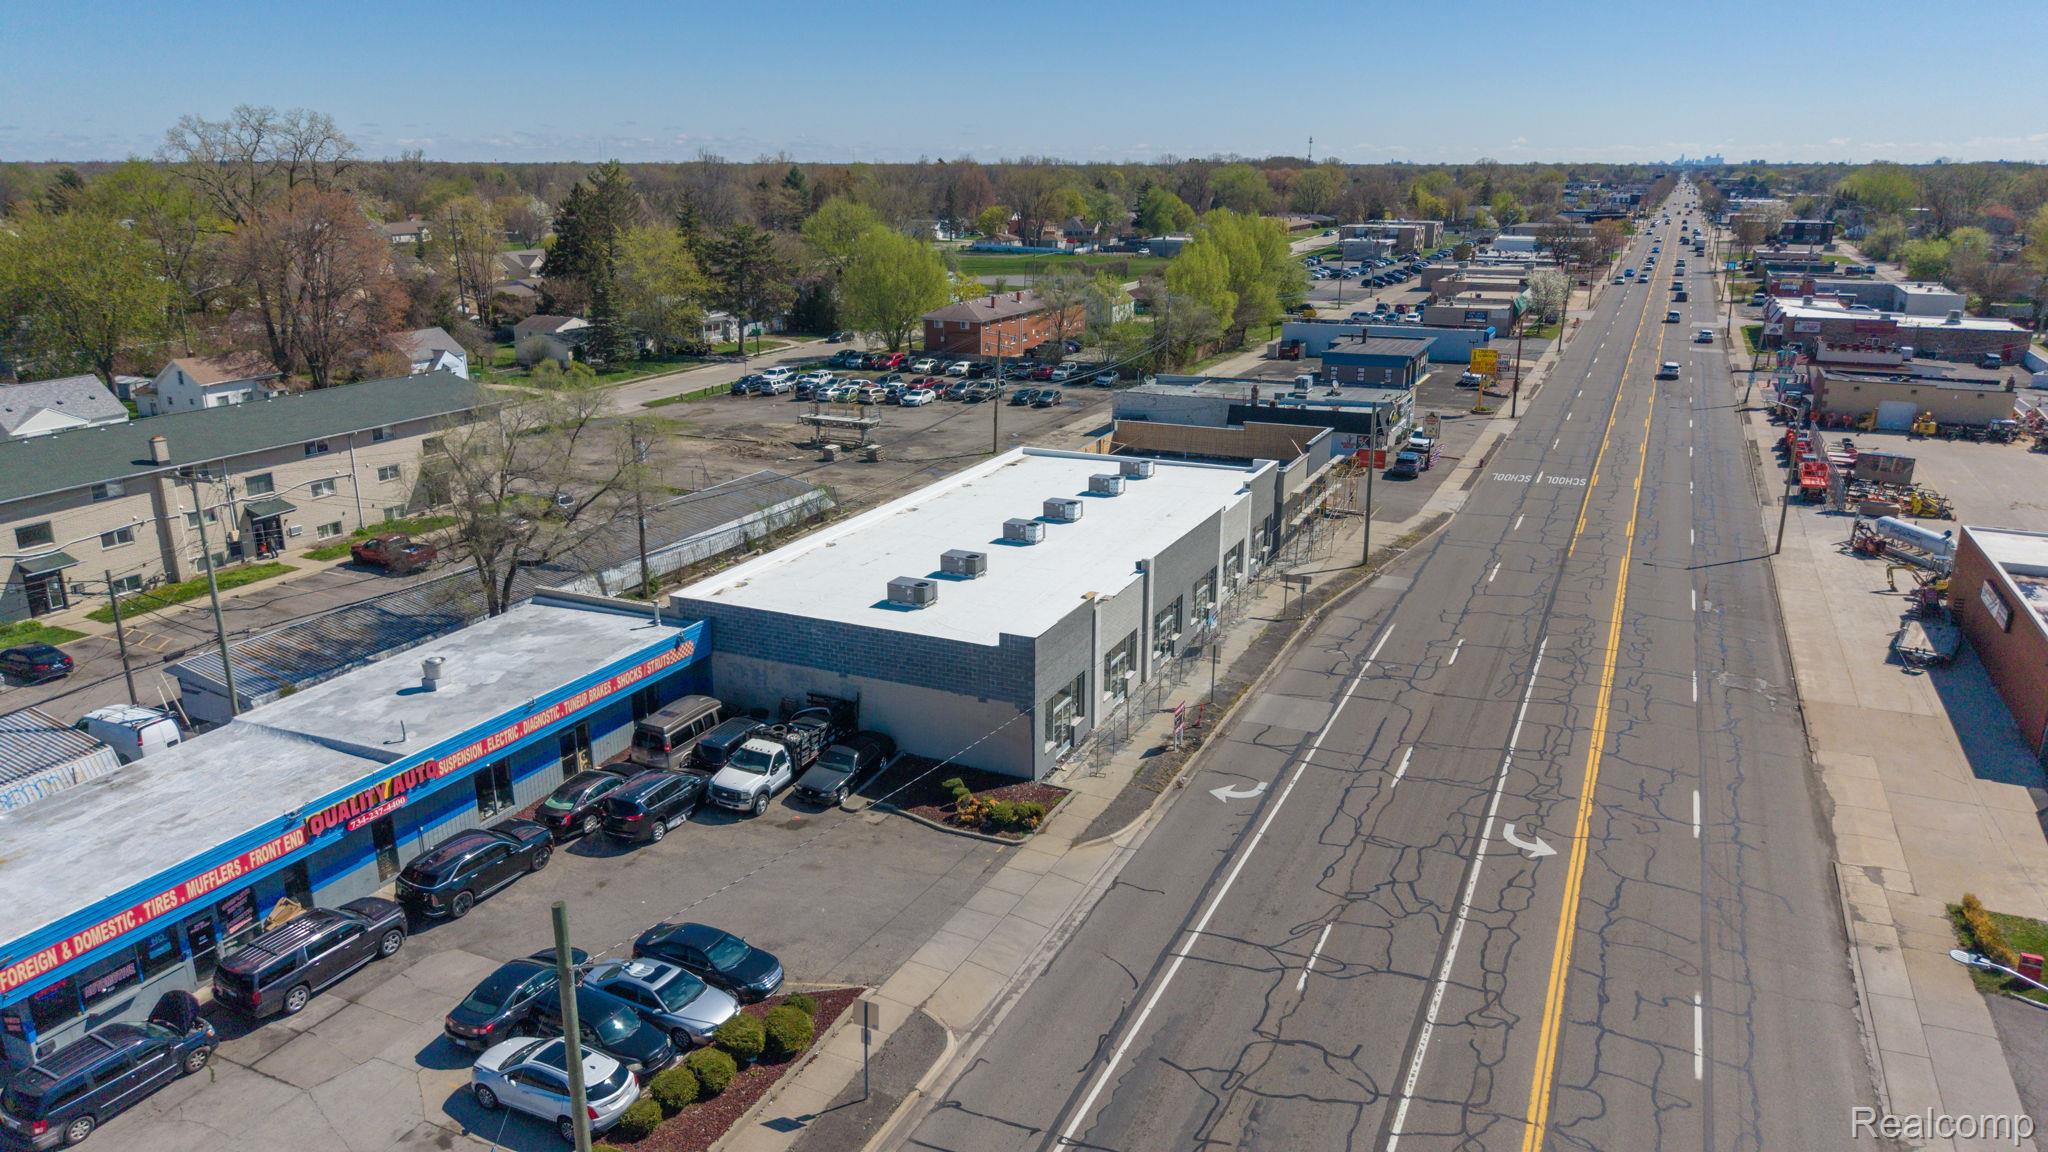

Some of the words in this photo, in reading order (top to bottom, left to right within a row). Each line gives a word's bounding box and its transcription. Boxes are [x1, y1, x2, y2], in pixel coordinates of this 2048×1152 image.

[1492, 472, 1532, 483] SCHOOL
[1546, 475, 1586, 486] SCHOOL
[438, 744, 483, 775] SUSPENSION
[487, 726, 519, 752] ELECTRIC
[523, 705, 560, 733] DIAGNOSTIC
[588, 681, 611, 702] BRAKES
[617, 667, 643, 689] SHOCKS
[647, 653, 671, 674] STRUTS
[309, 782, 387, 835] QUALITY
[392, 760, 437, 797] AUTO
[350, 796, 405, 829] 734-237-4400
[0, 946, 58, 991] FOREIGN
[61, 941, 72, 960] &
[74, 911, 136, 954] DOMESTIC
[143, 890, 178, 919] TIRES
[186, 859, 241, 899] MUFFLERS
[249, 839, 282, 868] FRONT
[283, 829, 304, 851] END
